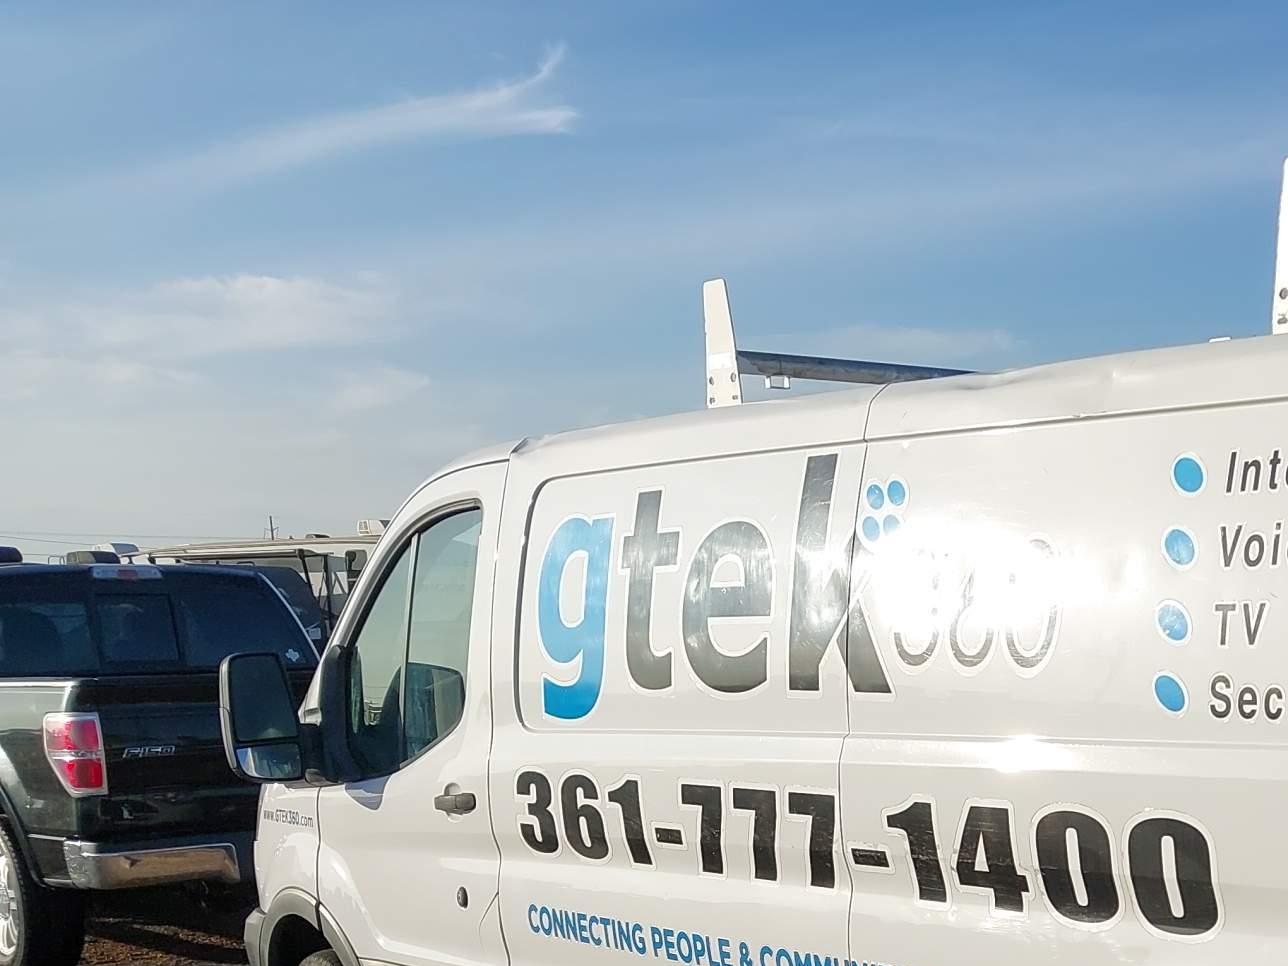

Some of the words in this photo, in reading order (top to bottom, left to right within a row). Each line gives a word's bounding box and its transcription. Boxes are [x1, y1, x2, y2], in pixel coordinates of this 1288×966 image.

[538, 453, 892, 720] gtek
[1215, 602, 1267, 646] TV
[515, 769, 1221, 937] 361-777-1400
[528, 905, 647, 956] CONNECTING
